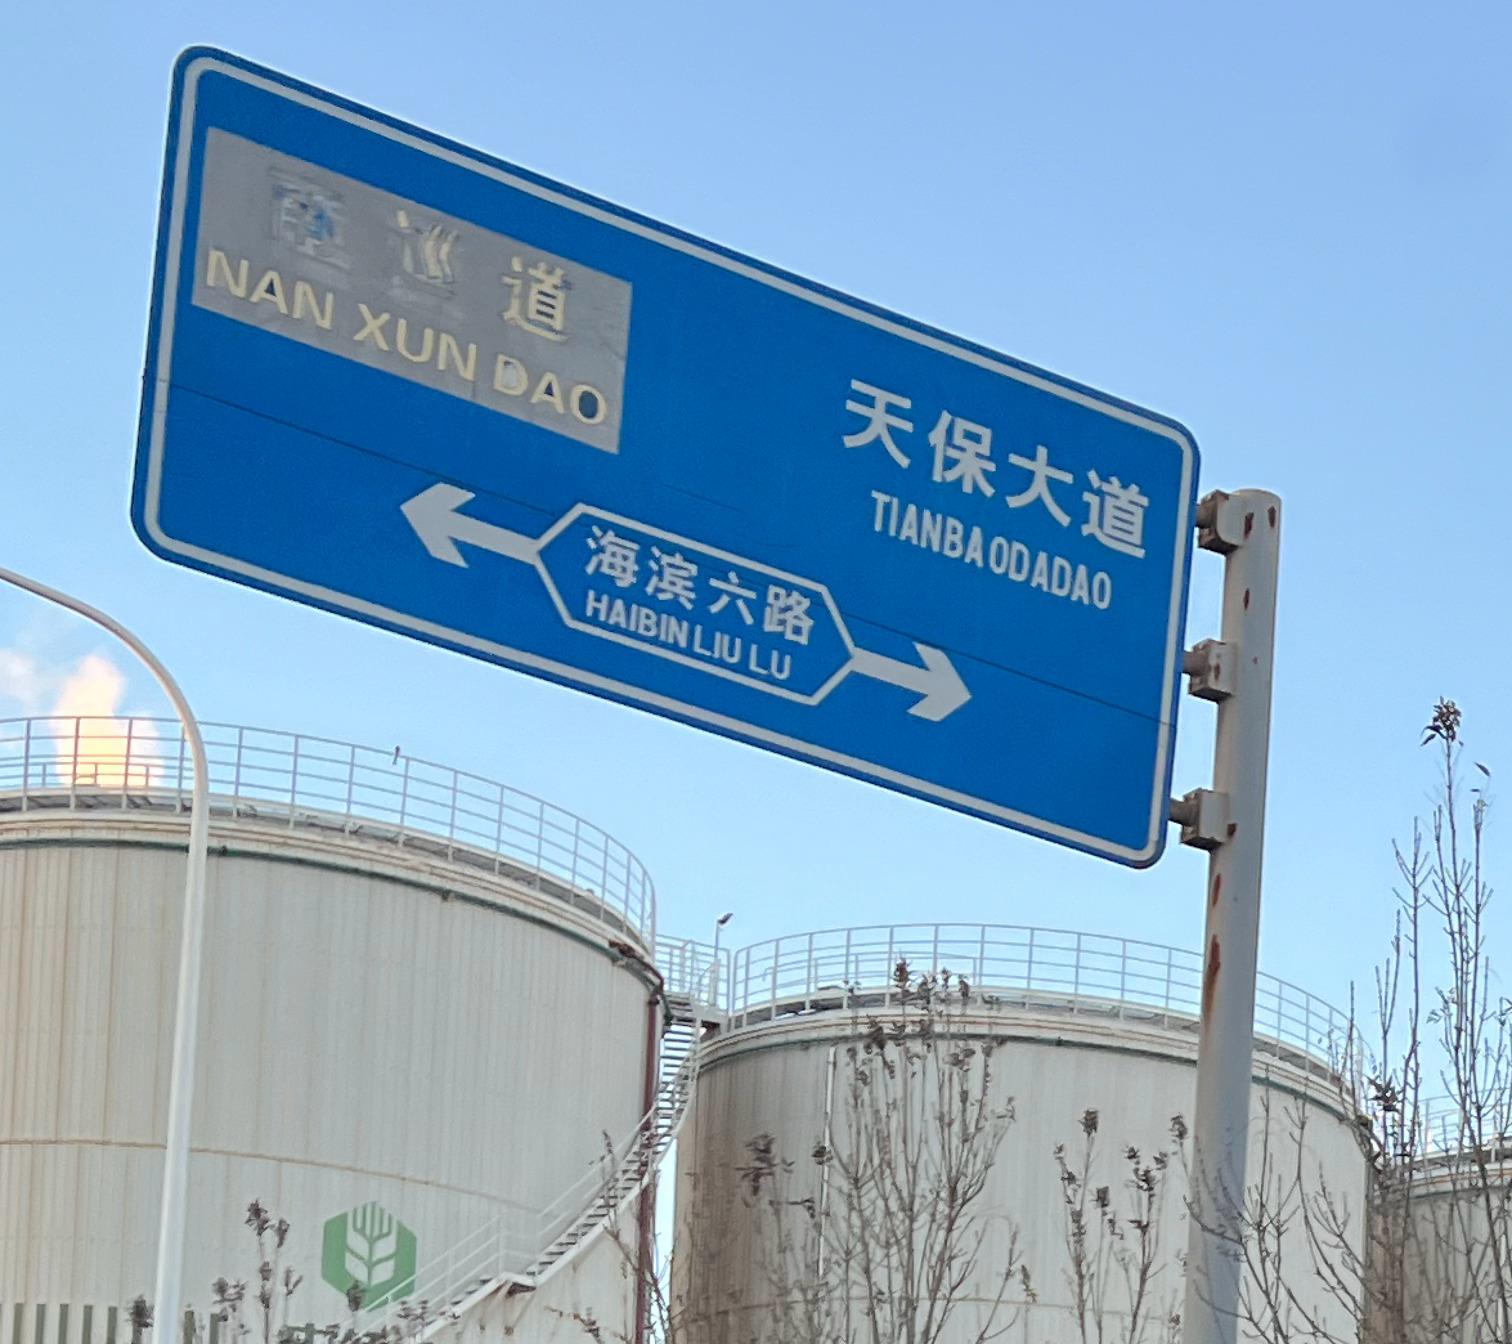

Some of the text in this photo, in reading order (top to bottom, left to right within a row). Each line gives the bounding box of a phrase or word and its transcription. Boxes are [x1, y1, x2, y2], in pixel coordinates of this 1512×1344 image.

[206, 249, 609, 426] NAN XUN DAO
[842, 378, 1149, 559] 天保大道
[585, 525, 814, 645] 海滨六路
[586, 589, 791, 680] HAIBIN LIU LU
